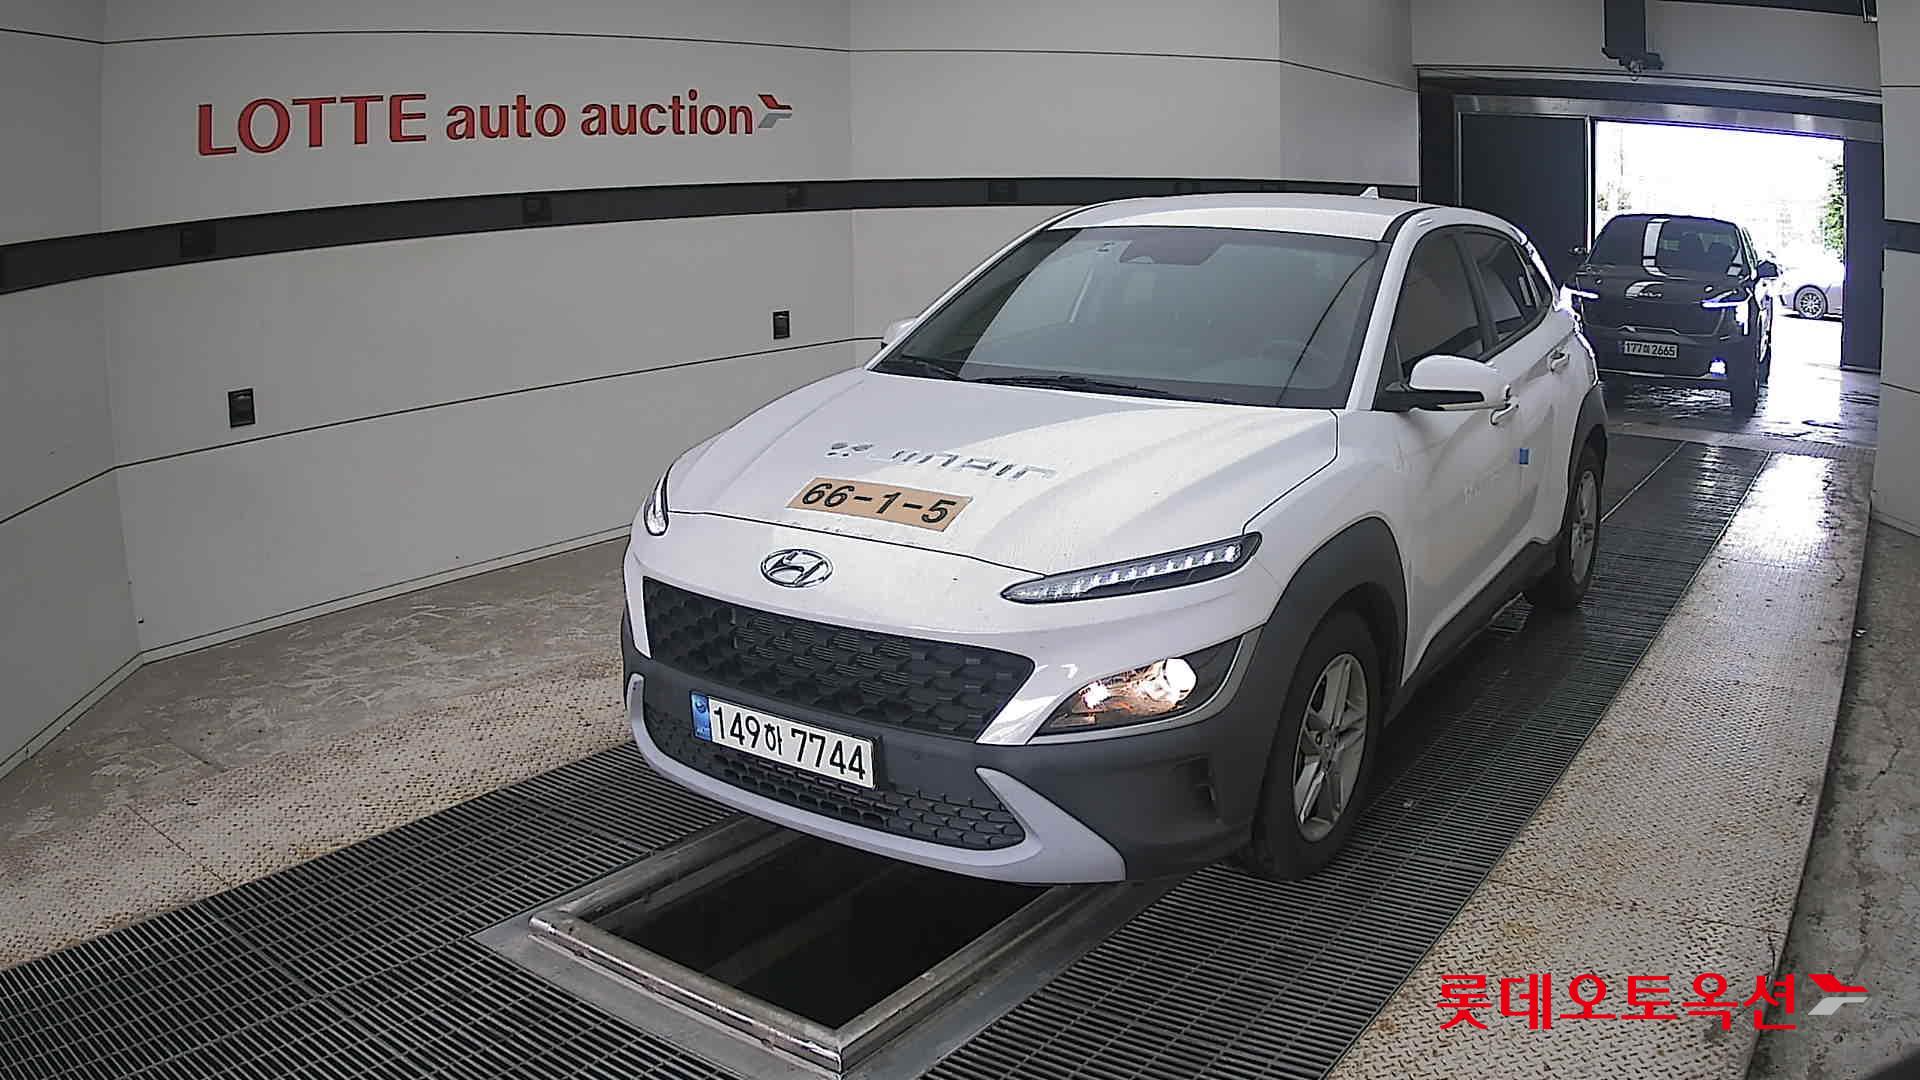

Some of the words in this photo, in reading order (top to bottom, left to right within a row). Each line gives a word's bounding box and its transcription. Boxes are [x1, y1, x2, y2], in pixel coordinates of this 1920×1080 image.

[198, 93, 427, 156] LOTTE
[446, 94, 567, 140] auto
[580, 89, 753, 136] auction
[1652, 344, 1675, 358] 2665
[802, 483, 957, 524] 66-1-5
[714, 706, 783, 756] 149하
[791, 727, 866, 780] 7744
